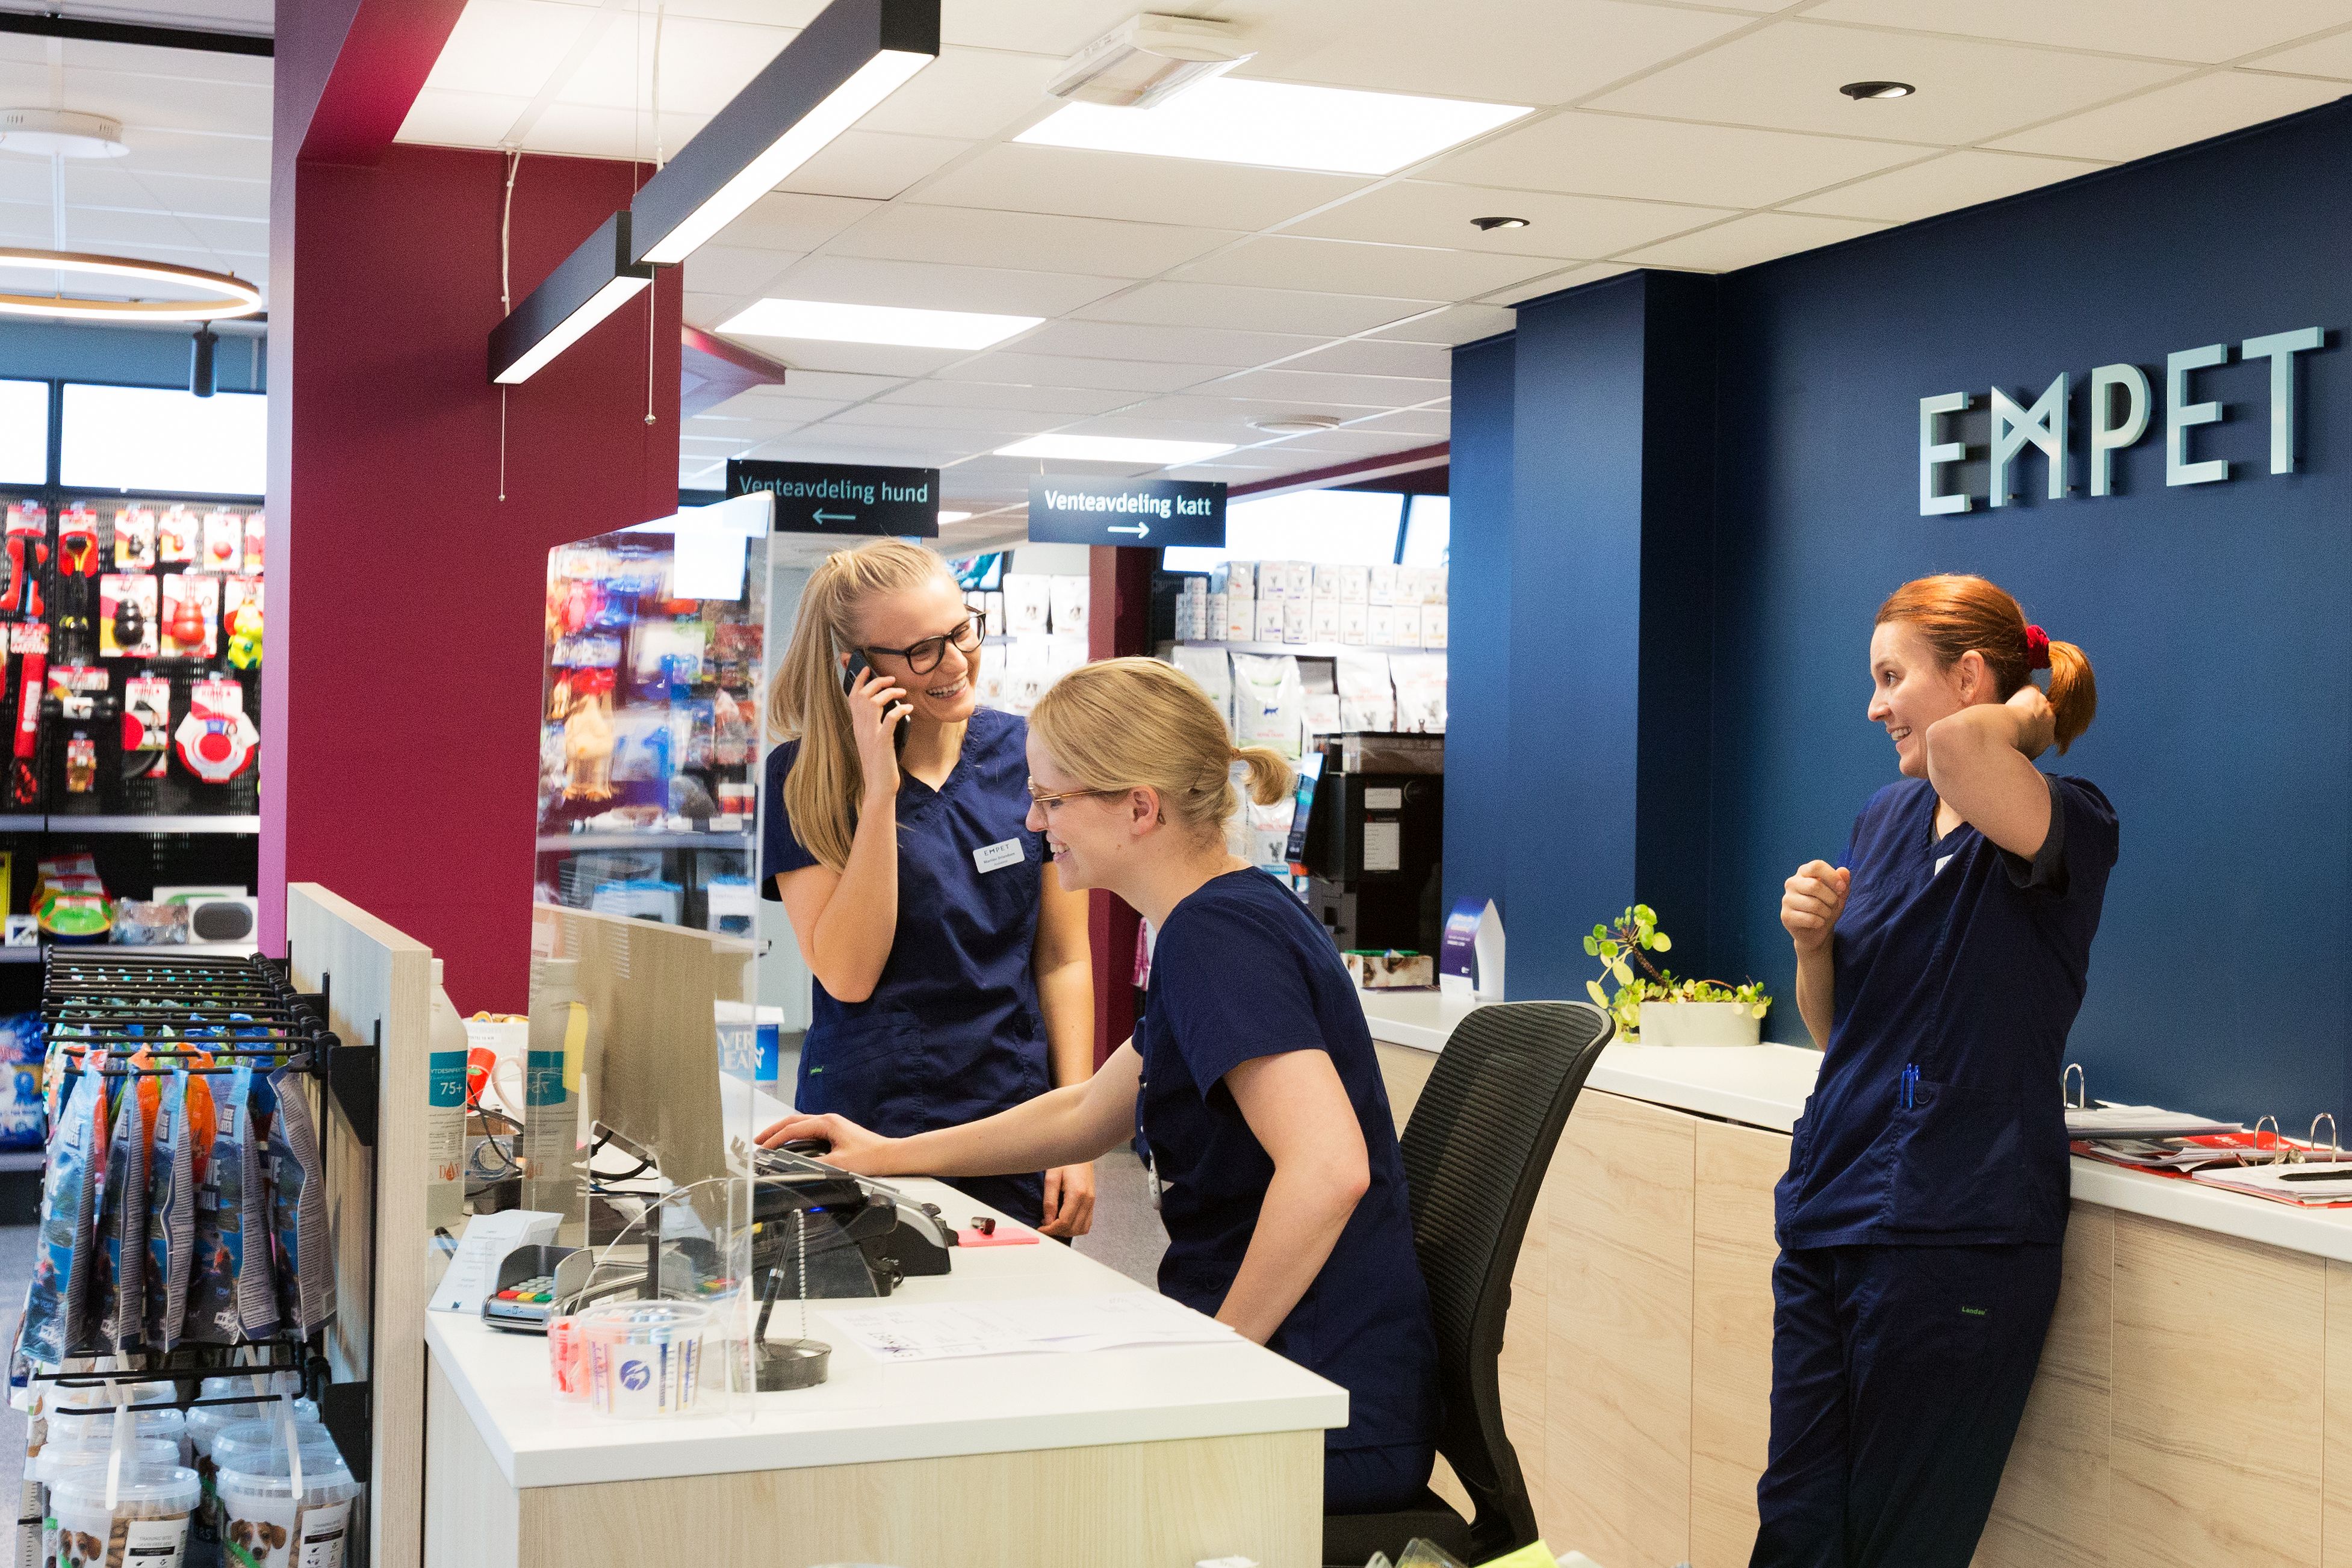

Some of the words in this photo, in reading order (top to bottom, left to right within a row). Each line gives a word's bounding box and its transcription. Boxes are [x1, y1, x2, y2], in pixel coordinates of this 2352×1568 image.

[1920, 326, 2324, 516] EMPET
[739, 476, 875, 505] Venteavdeling
[882, 482, 928, 503] hund
[1044, 490, 1171, 518] Venteavdeling
[1177, 494, 1212, 516] katt
[984, 844, 1010, 856] EMPET
[440, 1082, 462, 1095] 75+
[1962, 1306, 1985, 1315] Landau
